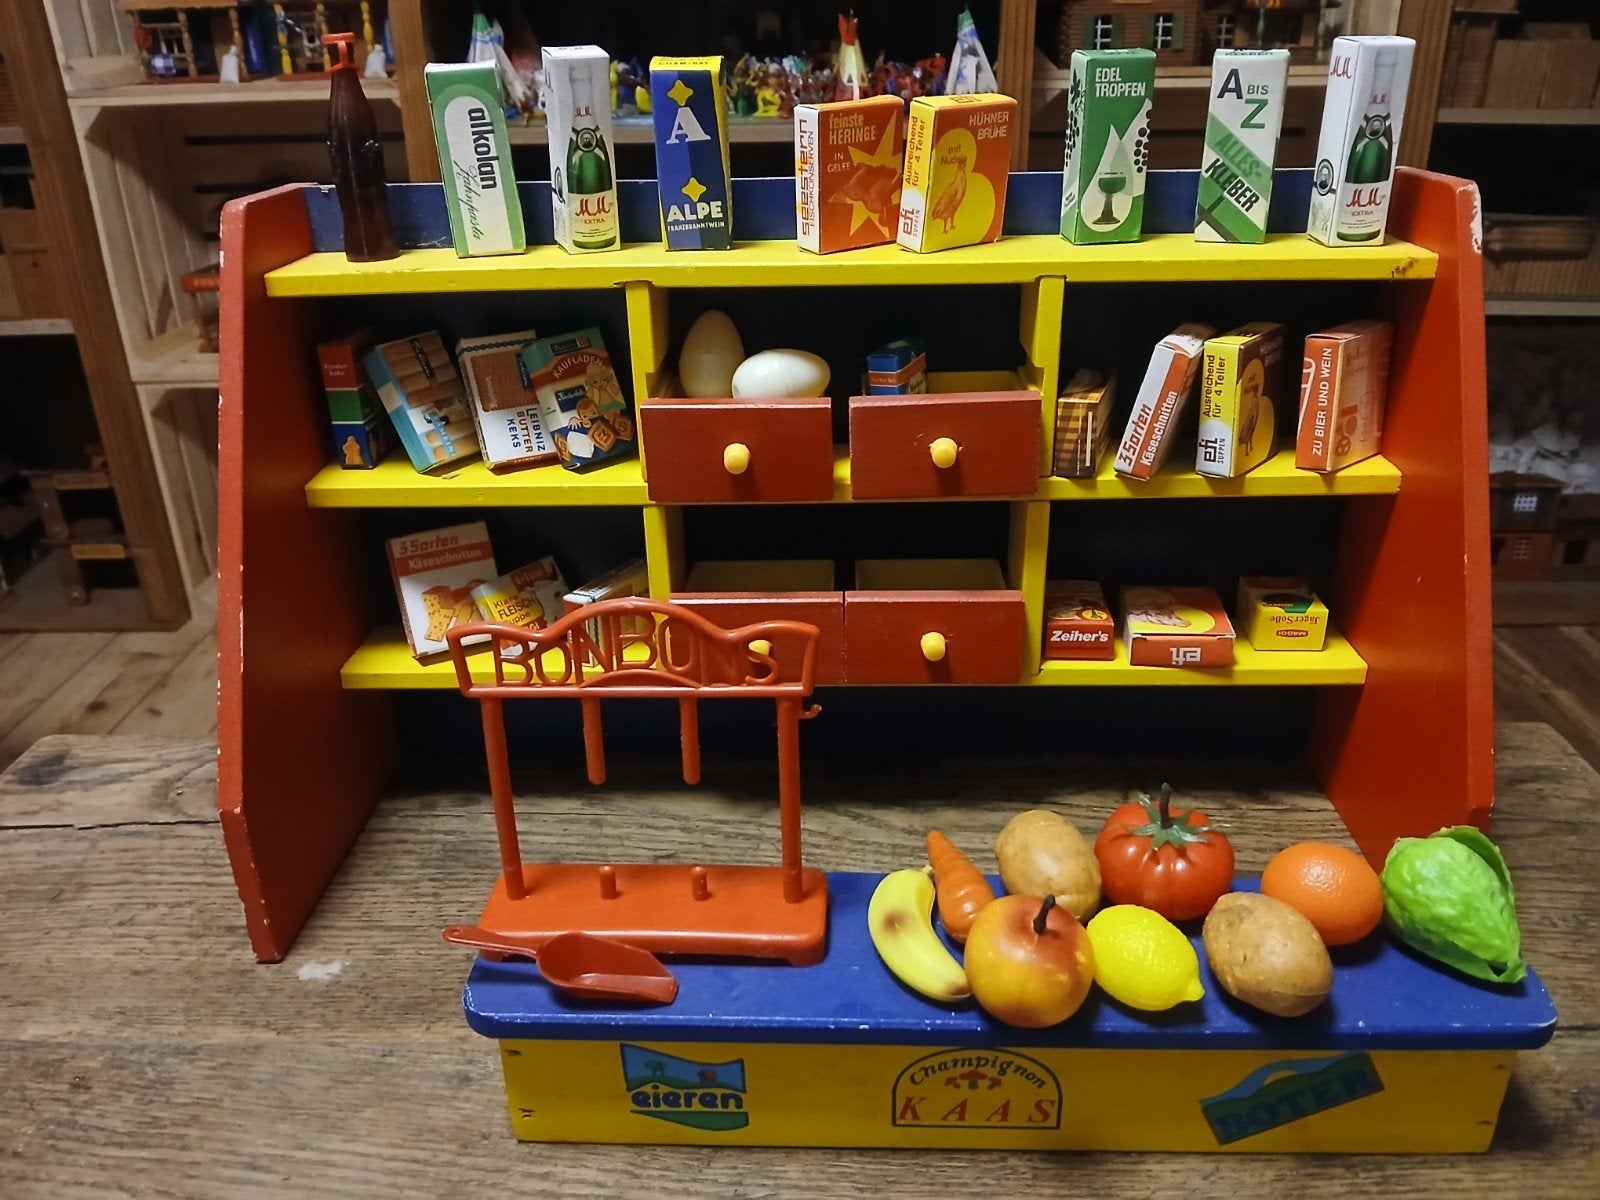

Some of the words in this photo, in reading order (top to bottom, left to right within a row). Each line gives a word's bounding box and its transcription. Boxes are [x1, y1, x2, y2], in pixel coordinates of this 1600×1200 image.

[1095, 67, 1122, 82] EDEL
[1216, 68, 1243, 99] A
[1247, 85, 1269, 95] BIS
[1095, 82, 1146, 98] TROPFEN
[666, 106, 711, 145] A
[829, 113, 864, 130] feinste
[969, 111, 1009, 126] HÜHNER
[1240, 98, 1266, 129] Z
[828, 125, 876, 145] HERINGE
[915, 119, 926, 151] Teller
[977, 125, 1008, 140] BRÜHE
[468, 107, 499, 190] alkolan
[834, 152, 844, 161] IN
[906, 115, 918, 185] Ausreichend
[915, 155, 921, 163] 4
[948, 144, 961, 153] mit
[1215, 133, 1262, 178] ALLES-
[798, 118, 810, 236] seestern
[912, 172, 920, 187] für
[1205, 157, 1261, 213] KLEBER
[584, 217, 606, 225] EXTRA
[667, 200, 723, 222] ALPE
[900, 207, 915, 235] efi
[668, 221, 725, 232] FRANZBRANNTWEIN
[553, 355, 603, 378] KAUFLADEN
[1215, 357, 1226, 385] Teller
[1321, 347, 1332, 379] WEIN
[1202, 355, 1215, 418] Ausreichend
[1216, 389, 1223, 397] 4
[1318, 381, 1329, 406] UND
[1212, 404, 1221, 418] für
[1315, 410, 1326, 437] BIER
[507, 418, 521, 448] KEKS
[516, 411, 533, 453] BUTTER
[526, 407, 546, 452] LEIBNIZ
[1124, 403, 1152, 454] Sorten
[1140, 390, 1178, 466] Käseschnitten
[1199, 437, 1218, 463] efi
[1217, 438, 1226, 464] SUPPEN
[1312, 439, 1323, 457] ZU
[1119, 455, 1131, 467] 3
[398, 541, 408, 555] 3
[409, 535, 458, 553] Sorten
[408, 549, 483, 569] Käseschnitten
[498, 596, 539, 620] FLEISCH
[1270, 615, 1293, 625] Soße
[1294, 615, 1320, 625] Jäger
[496, 602, 780, 686] BONBONS
[1050, 630, 1109, 642] Zeiher's
[1169, 647, 1202, 665] efi
[909, 1055, 1047, 1089] Champignon
[631, 1083, 743, 1110] eieren
[1214, 1069, 1379, 1142] BOTER
